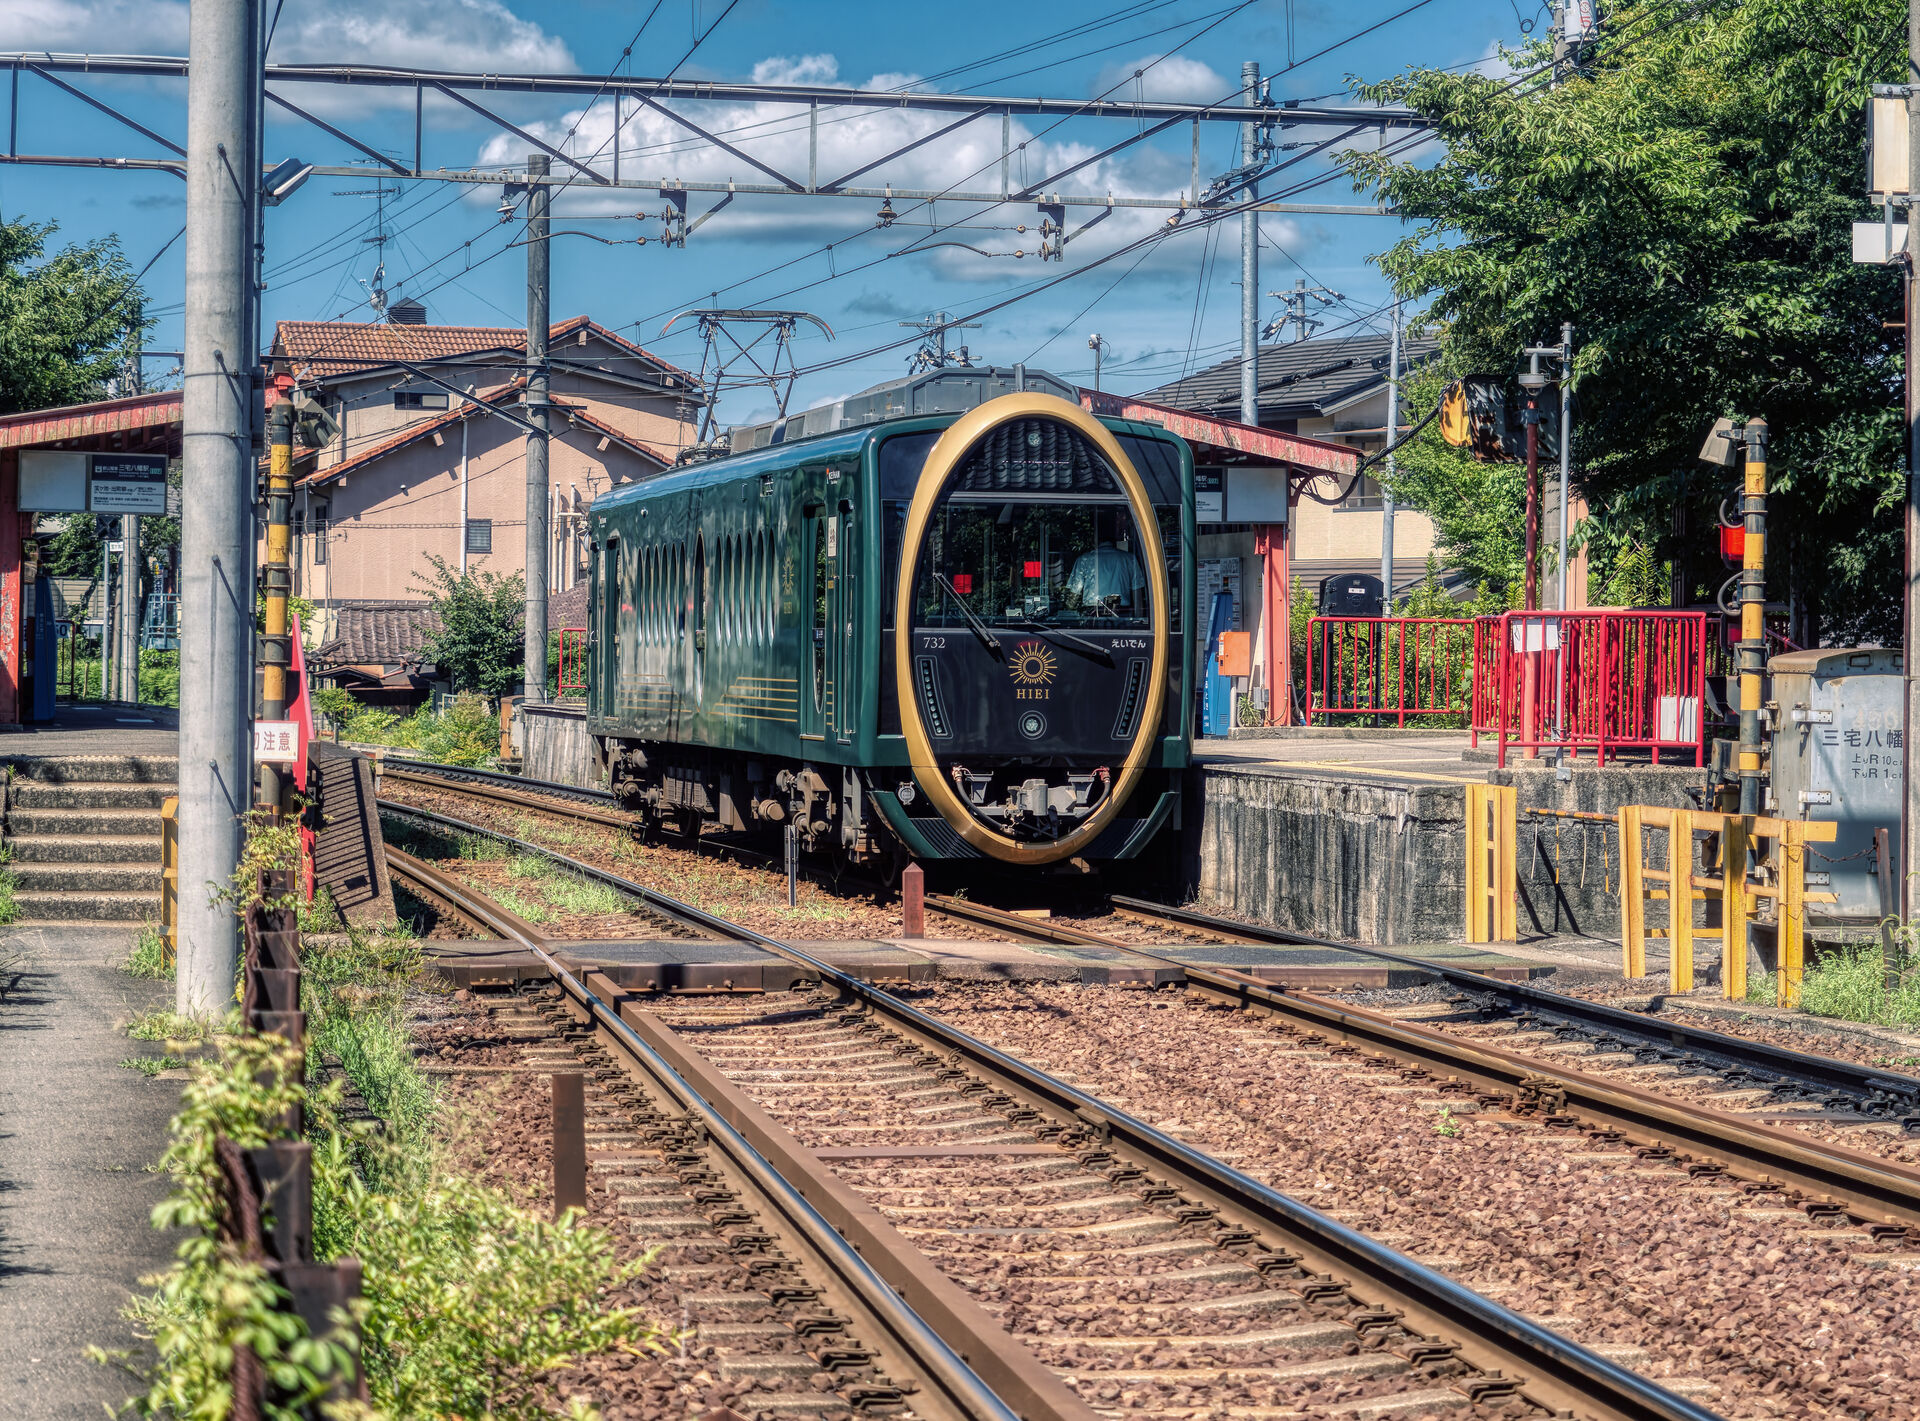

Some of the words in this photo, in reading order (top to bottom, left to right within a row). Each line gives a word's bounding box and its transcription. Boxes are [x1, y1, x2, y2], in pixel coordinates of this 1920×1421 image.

[923, 637, 946, 649] 732
[1111, 639, 1146, 649] えいでん
[1016, 688, 1050, 700] HIEI
[1822, 728, 1903, 749] 三宅八幡
